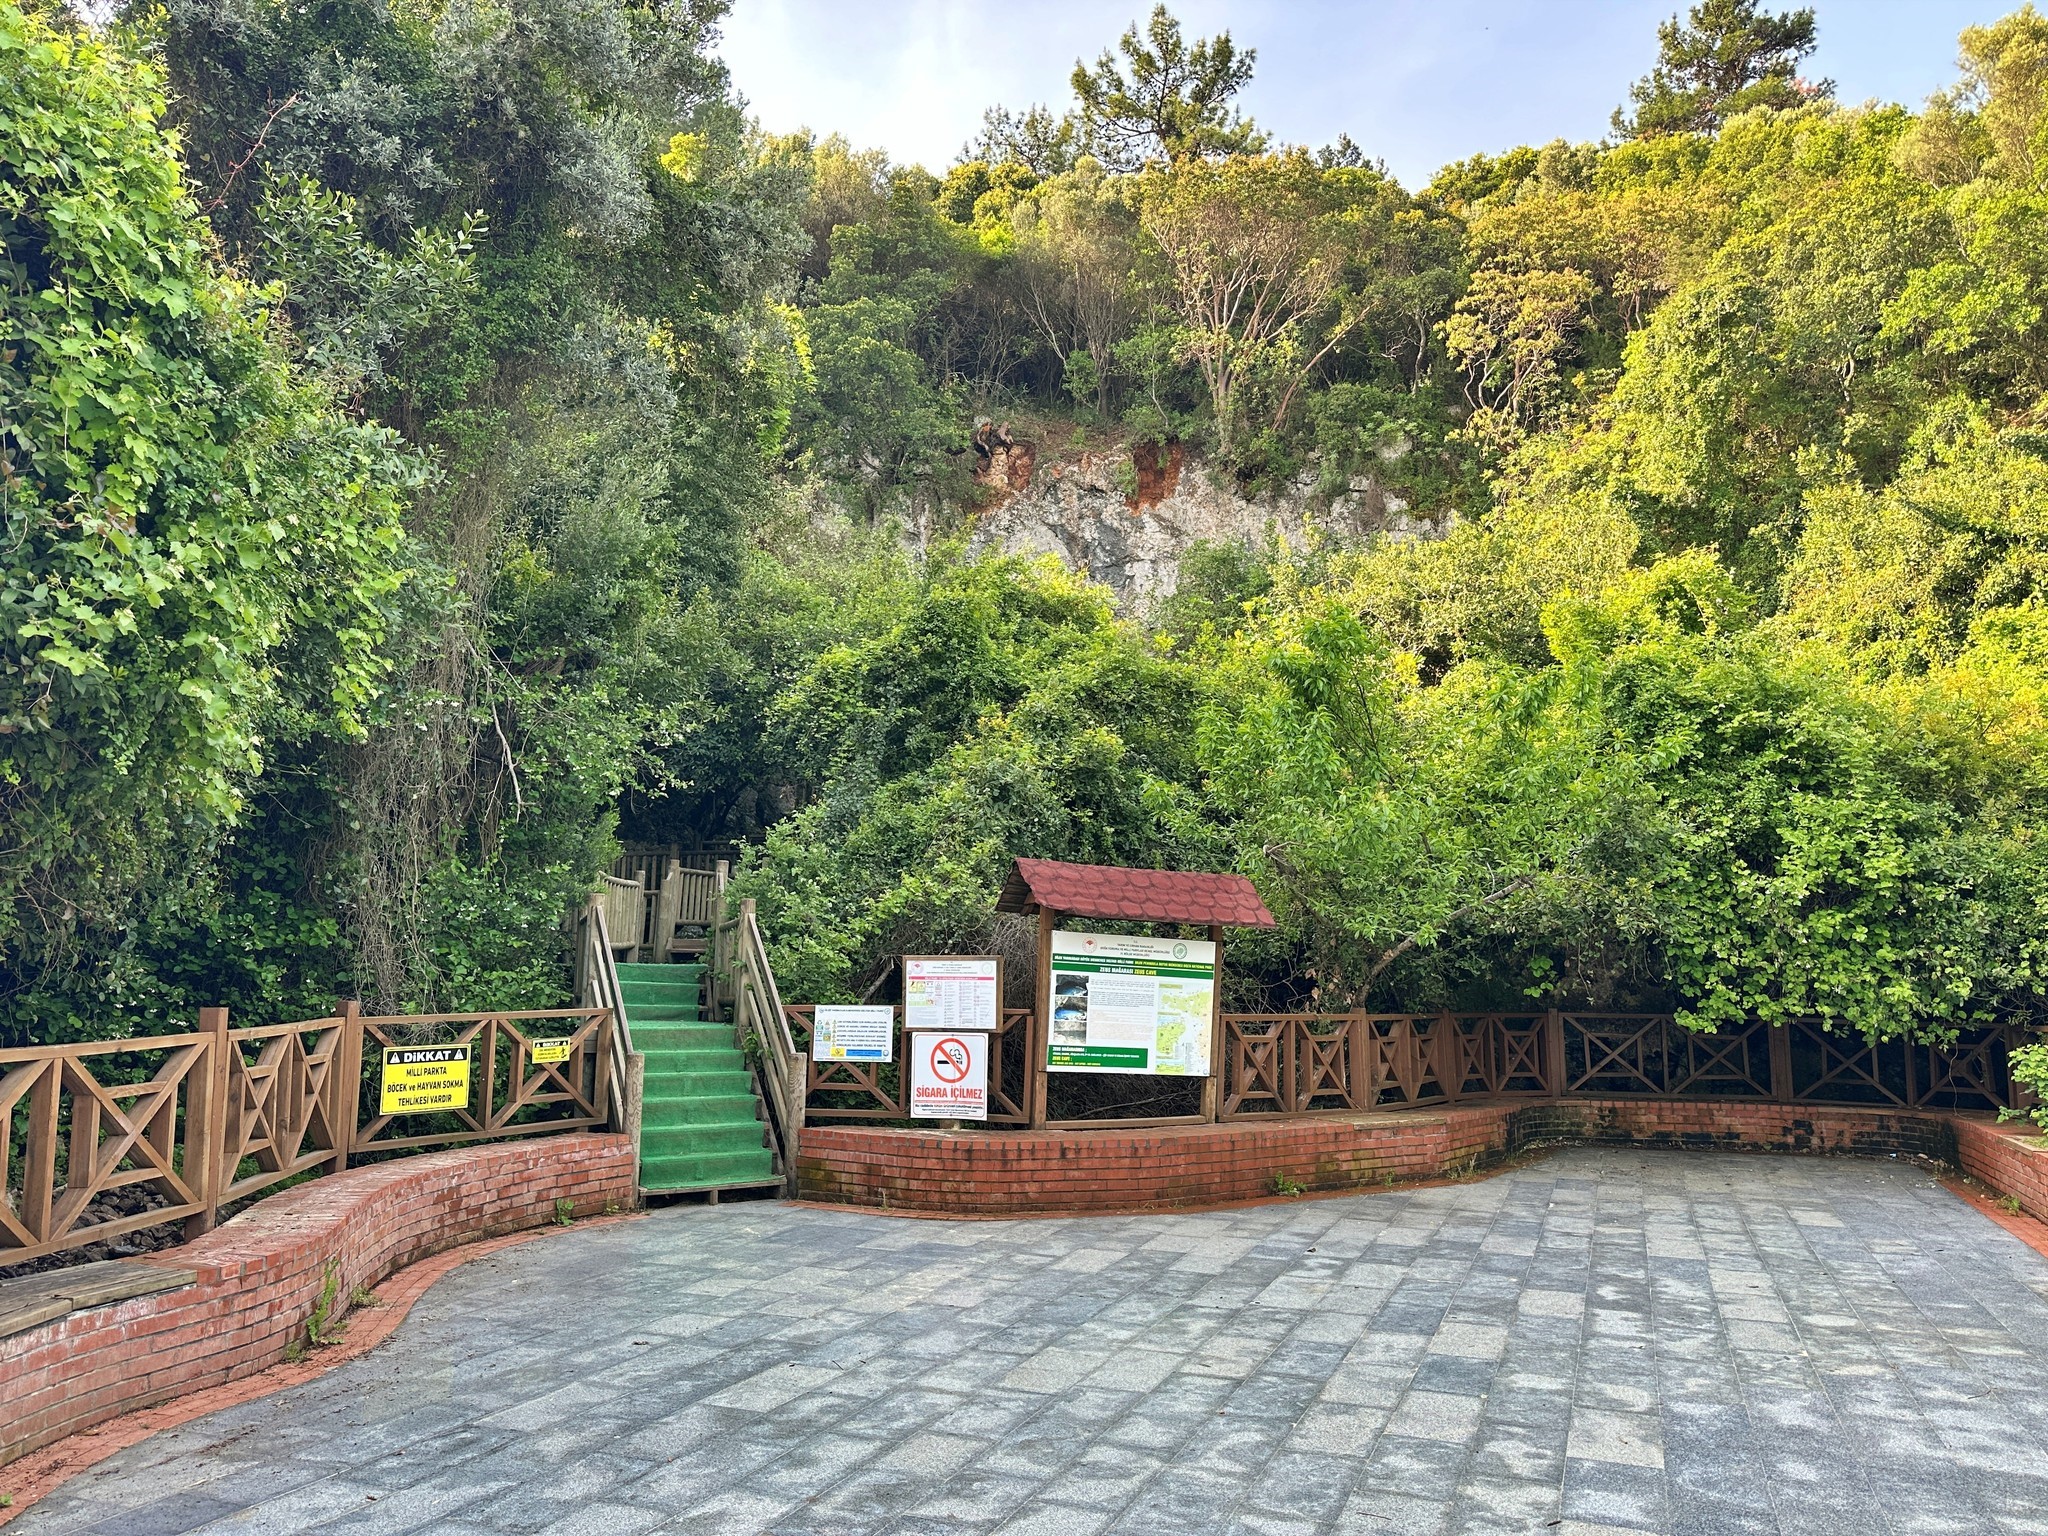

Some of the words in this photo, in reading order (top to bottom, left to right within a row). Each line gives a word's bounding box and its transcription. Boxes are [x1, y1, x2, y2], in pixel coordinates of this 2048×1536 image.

[406, 1066, 422, 1077] MİLLİ
[423, 1067, 447, 1076] PARKTA
[387, 1082, 407, 1093] BÖCEK
[417, 1081, 441, 1091] HAYVAN
[442, 1079, 464, 1089] SOKMA
[916, 1085, 948, 1098] SİGARA
[950, 1085, 983, 1100] İÇİLMEZ
[398, 1094, 430, 1106] TEHLİKESİ
[430, 1094, 452, 1104] VARDIR
